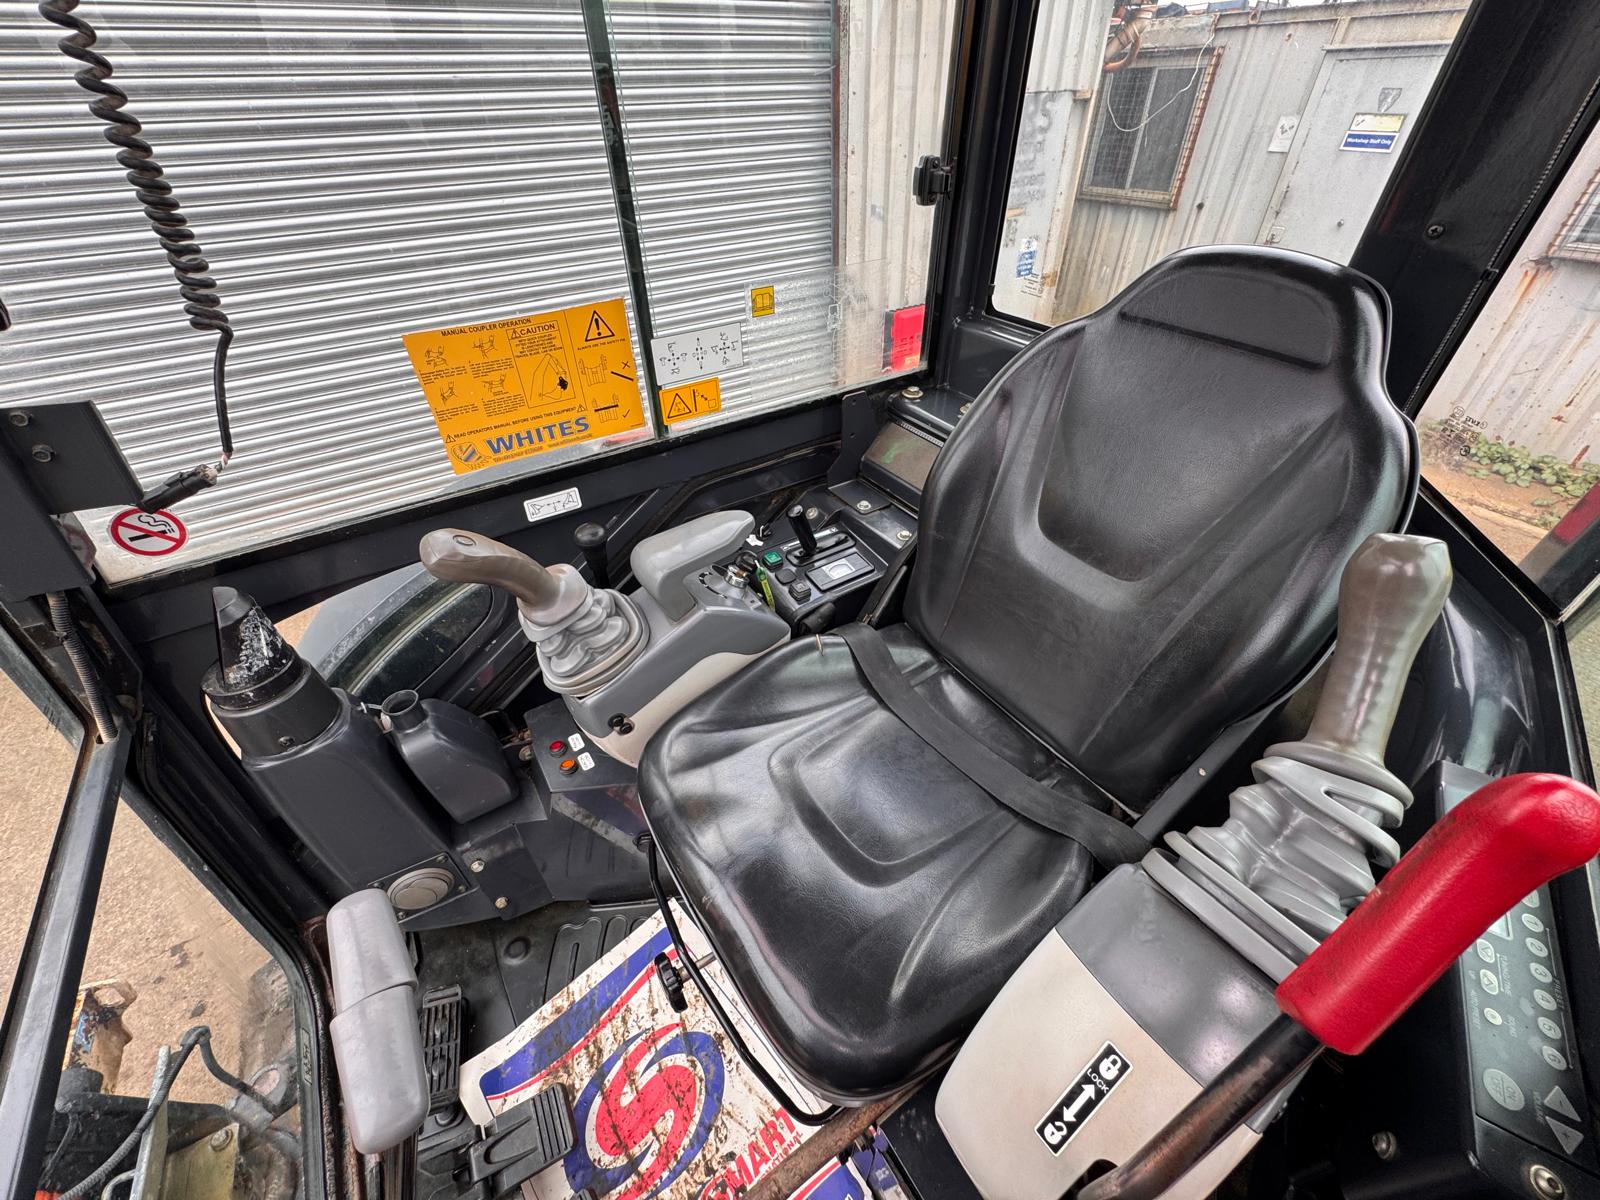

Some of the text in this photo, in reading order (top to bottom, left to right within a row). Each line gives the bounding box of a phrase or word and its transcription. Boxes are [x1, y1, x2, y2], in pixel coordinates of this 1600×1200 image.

[441, 318, 531, 337] MANUAL COUPLER OPERATION
[519, 323, 555, 336] CAUTION
[467, 426, 493, 436] OPERATORS
[493, 422, 511, 430] MANUAL
[554, 406, 577, 416] EQUIPMENT
[485, 415, 590, 455] WHITES
[1553, 977, 1565, 1009] PRESET
[1086, 1068, 1110, 1094] LOCK
